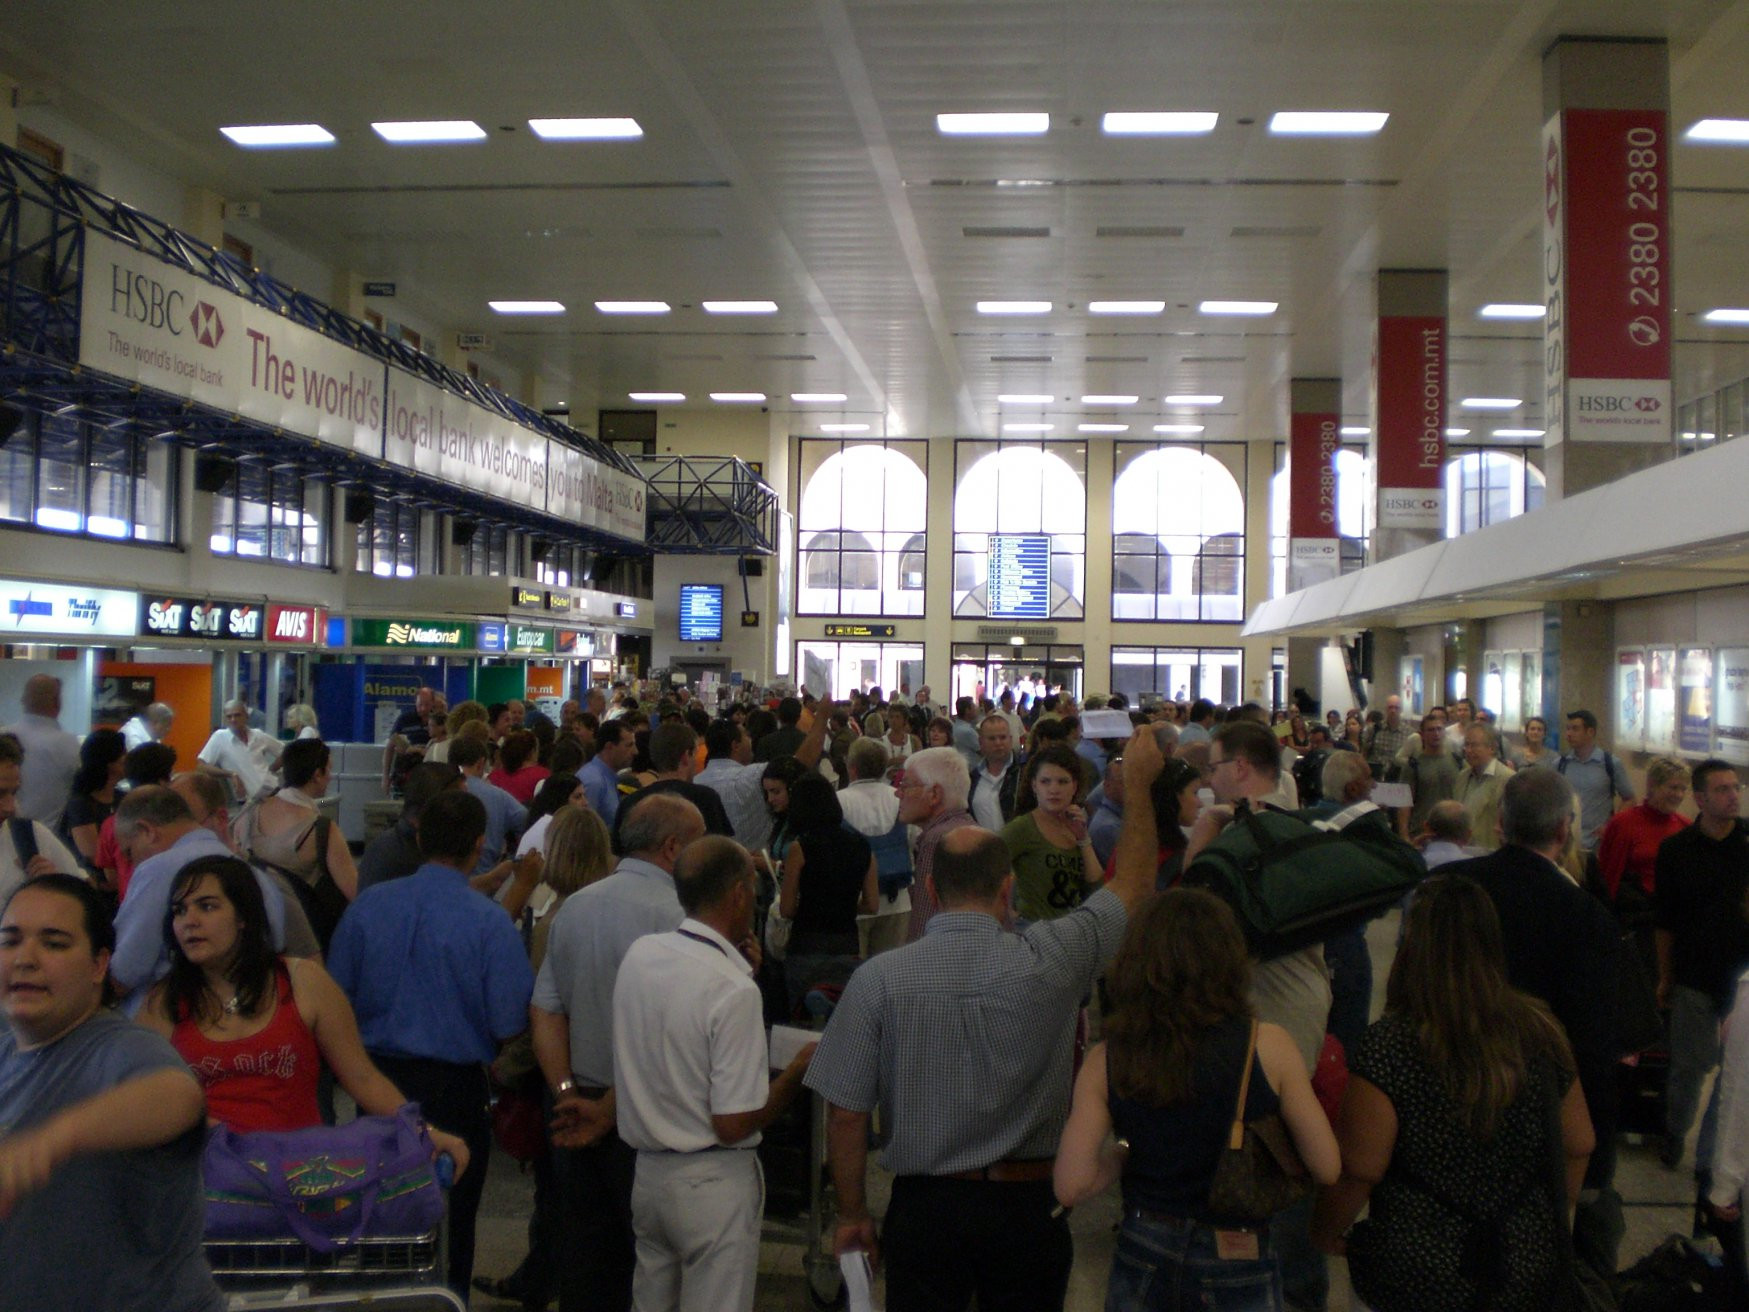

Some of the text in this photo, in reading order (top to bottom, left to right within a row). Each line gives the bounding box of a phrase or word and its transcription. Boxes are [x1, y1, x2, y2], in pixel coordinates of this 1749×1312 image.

[1627, 127, 1660, 306] 2380 2380
[111, 264, 183, 335] HSBC
[1546, 240, 1561, 428] HSBC
[108, 330, 223, 387] The world's local bank
[1419, 328, 1440, 469] hsbc.com.mt
[1579, 396, 1632, 411] HSBC
[246, 327, 613, 513] The world's local bank welcomes you to Malta
[1386, 499, 1418, 510] HSBC
[275, 610, 307, 637] AVIS
[408, 627, 460, 644] National
[517, 627, 545, 648] Europcar
[365, 682, 417, 696] Alamo
